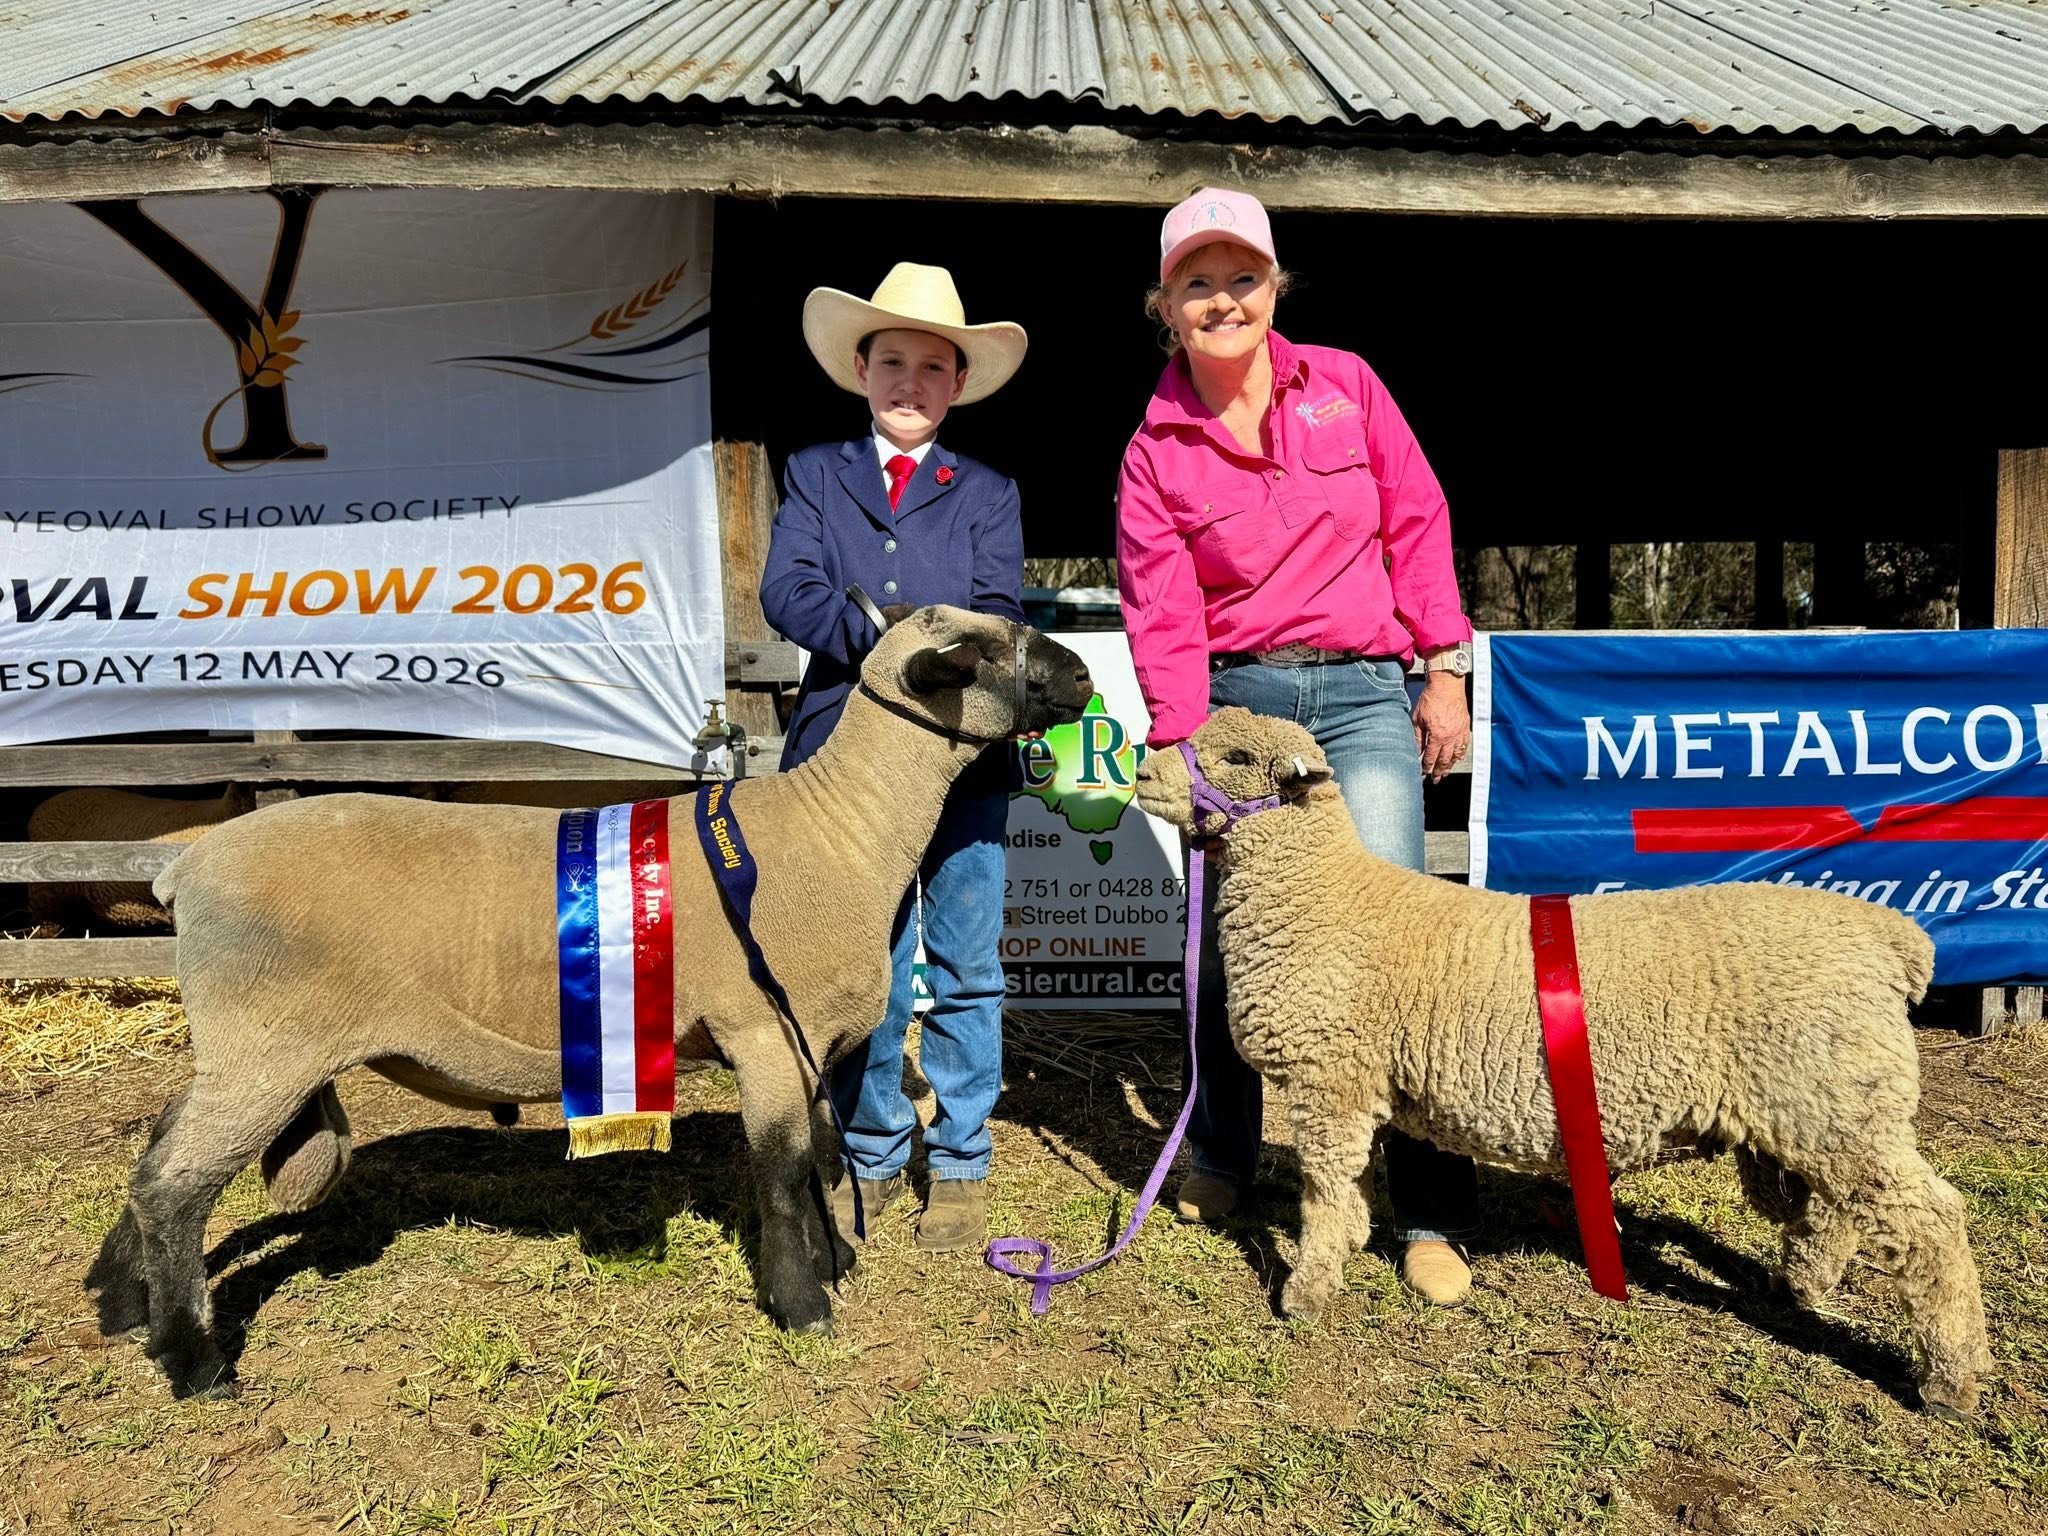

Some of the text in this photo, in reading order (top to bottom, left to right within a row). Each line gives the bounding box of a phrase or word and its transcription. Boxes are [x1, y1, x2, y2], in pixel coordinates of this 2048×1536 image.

[5, 495, 520, 533] YEOVAL SHOW SOCIETY
[0, 561, 647, 622] VAL SHOW 2026
[173, 652, 221, 680] 12
[242, 650, 354, 679] MAY
[375, 653, 505, 688] 2026
[563, 810, 585, 854] pion
[710, 817, 741, 868] Society
[1021, 879, 1058, 897] 751
[1069, 883, 1091, 897] or
[1099, 878, 1153, 897] 0428
[1905, 869, 1970, 912] in
[645, 889, 664, 930] Inc.
[1021, 905, 1087, 925] Street
[1096, 905, 1168, 925] Dubbo
[1050, 937, 1146, 957] ONLINE
